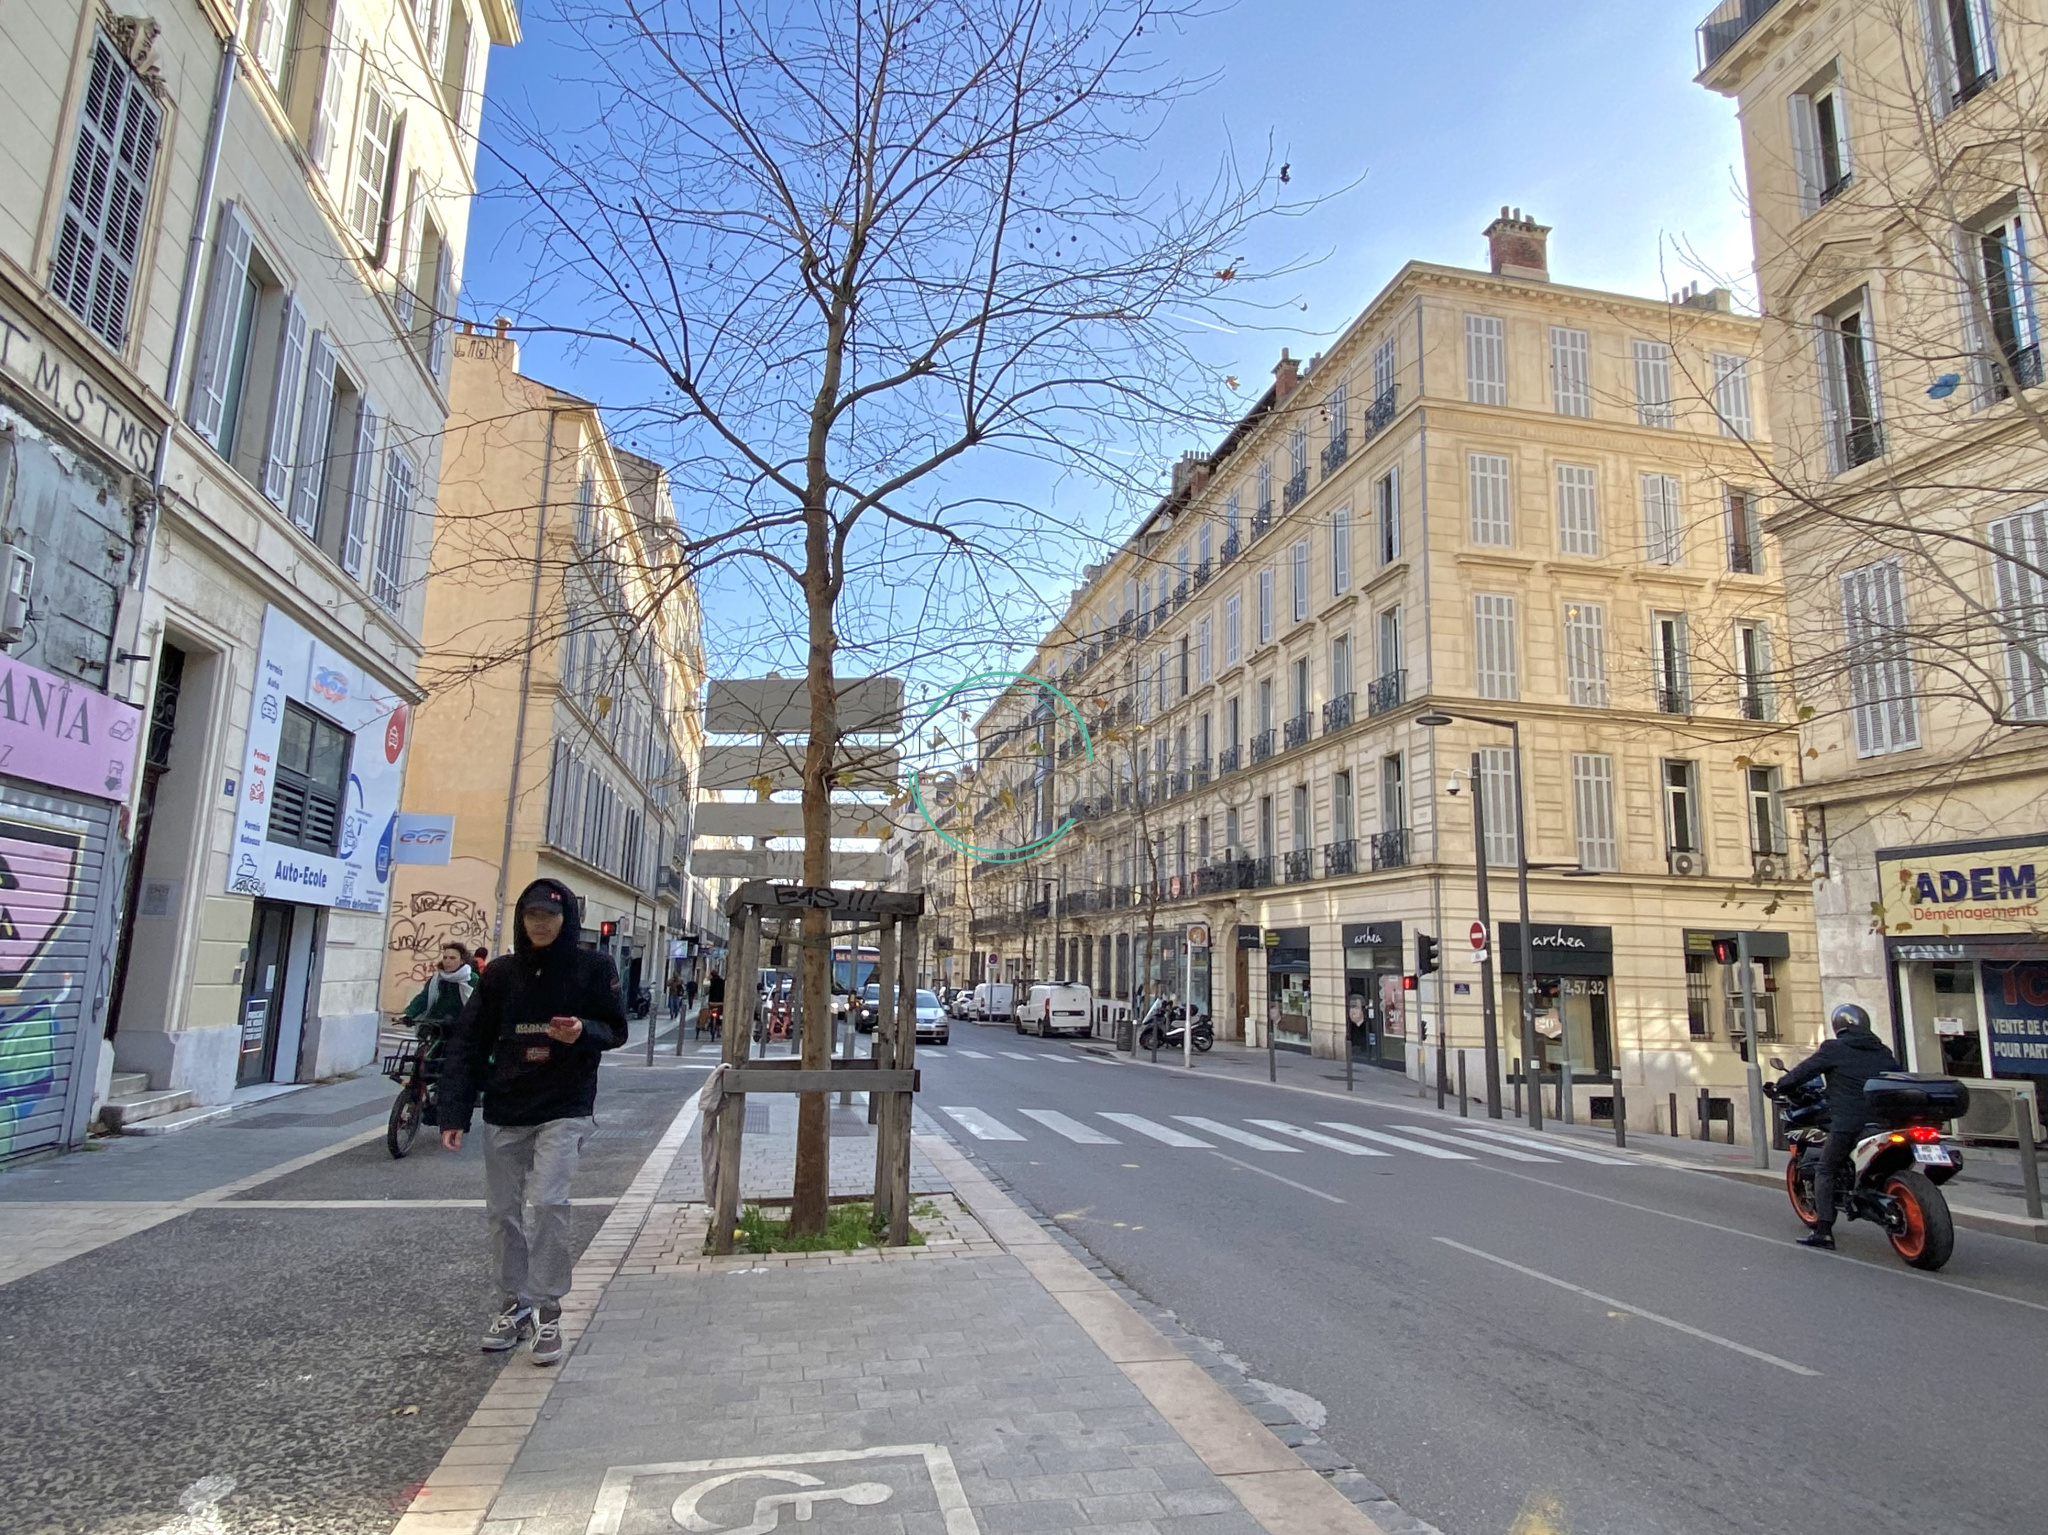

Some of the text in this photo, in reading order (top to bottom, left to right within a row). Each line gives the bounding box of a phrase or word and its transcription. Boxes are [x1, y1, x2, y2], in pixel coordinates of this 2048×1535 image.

[266, 659, 283, 676] Permis
[267, 677, 280, 690] Auto
[254, 748, 271, 763] Permis
[254, 764, 267, 777] Moto
[244, 820, 261, 832] Permis
[274, 860, 328, 888] Auto-Ecole
[1916, 864, 2037, 904] ADEM
[1913, 905, 2039, 921] Déménagements
[1354, 926, 1382, 944] archea
[1532, 928, 1585, 947] archea
[1992, 1018, 2025, 1035] VENTE
[2027, 1020, 2041, 1036] DE
[1993, 1042, 2048, 1059] POUR PART
